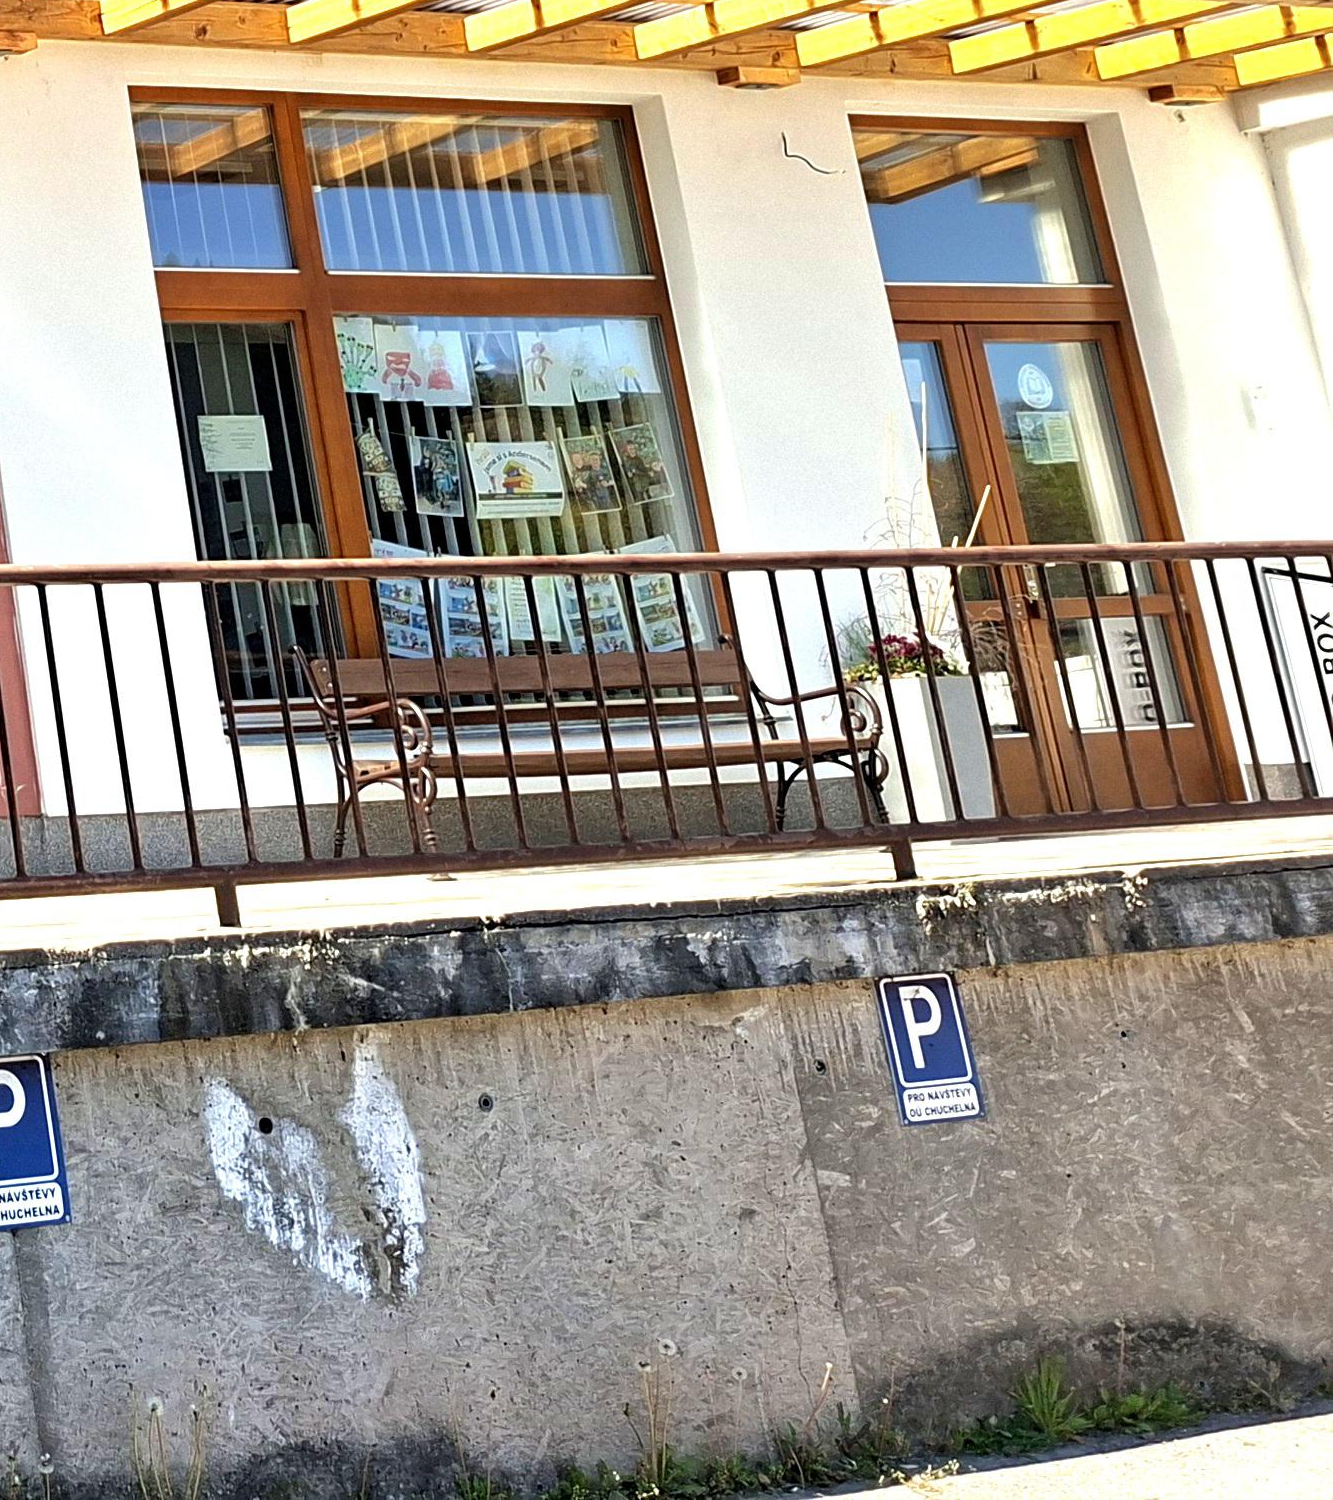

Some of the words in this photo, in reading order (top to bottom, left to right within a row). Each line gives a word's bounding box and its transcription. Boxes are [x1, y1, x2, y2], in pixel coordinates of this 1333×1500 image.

[898, 985, 942, 1069] P
[908, 1092, 925, 1103] PRO
[925, 1102, 976, 1116] CHUCHELNA
